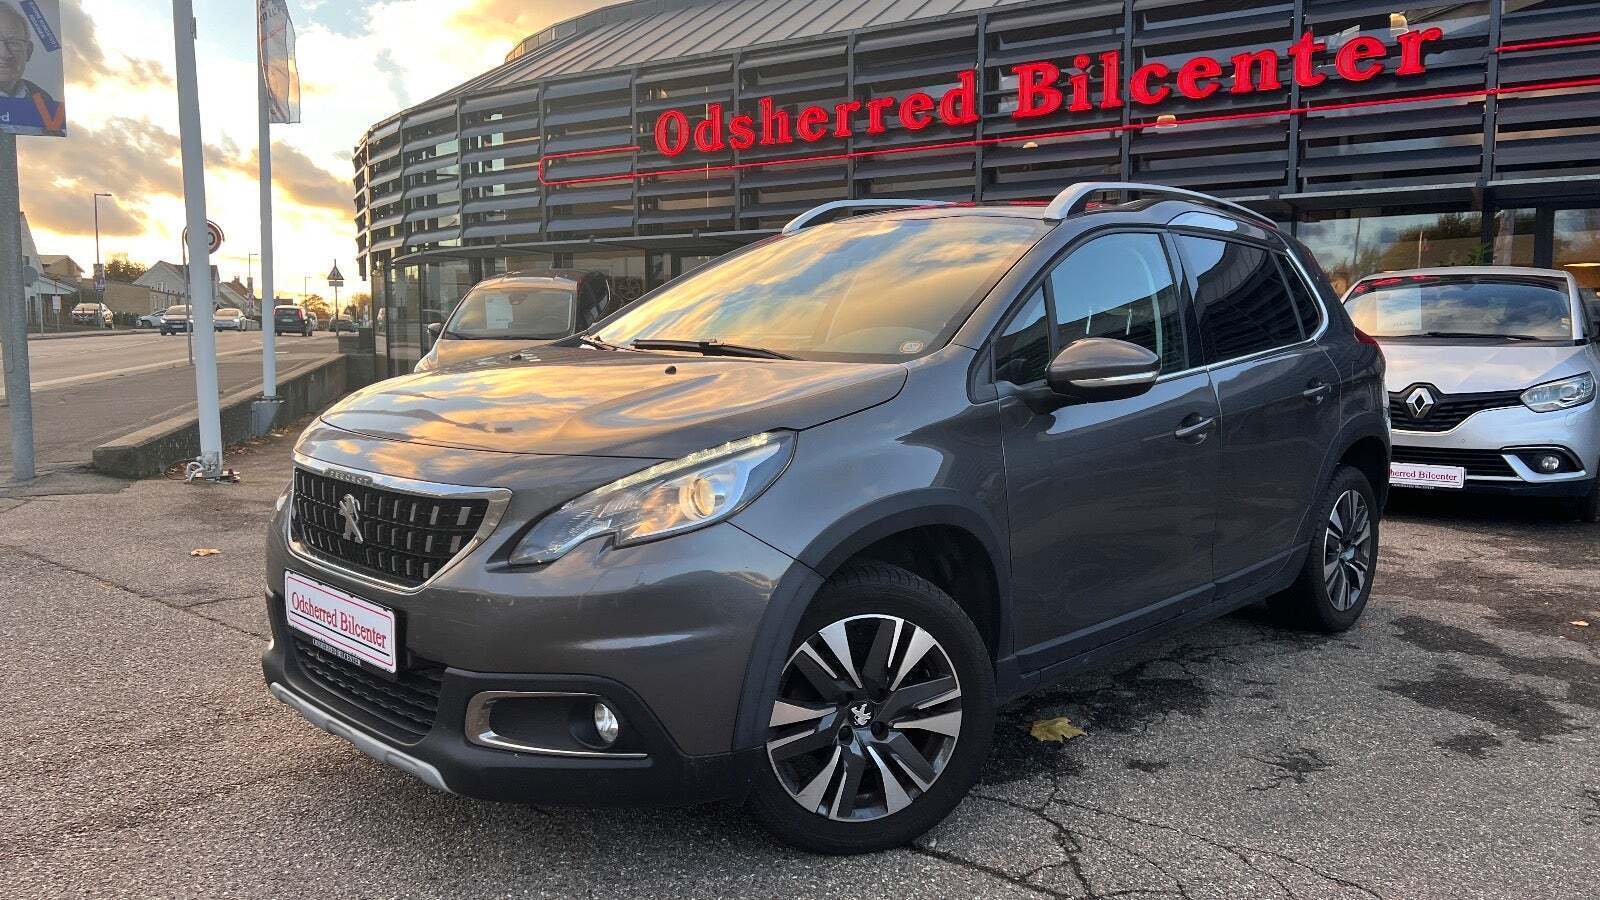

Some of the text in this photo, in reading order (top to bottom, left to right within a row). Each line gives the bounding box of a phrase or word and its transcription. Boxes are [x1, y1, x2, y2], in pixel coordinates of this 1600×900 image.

[653, 26, 1443, 158] Odsherred Bilcenter
[1389, 468, 1458, 481] herred Bilcenter
[291, 591, 387, 649] Odsherred Bilcenter
